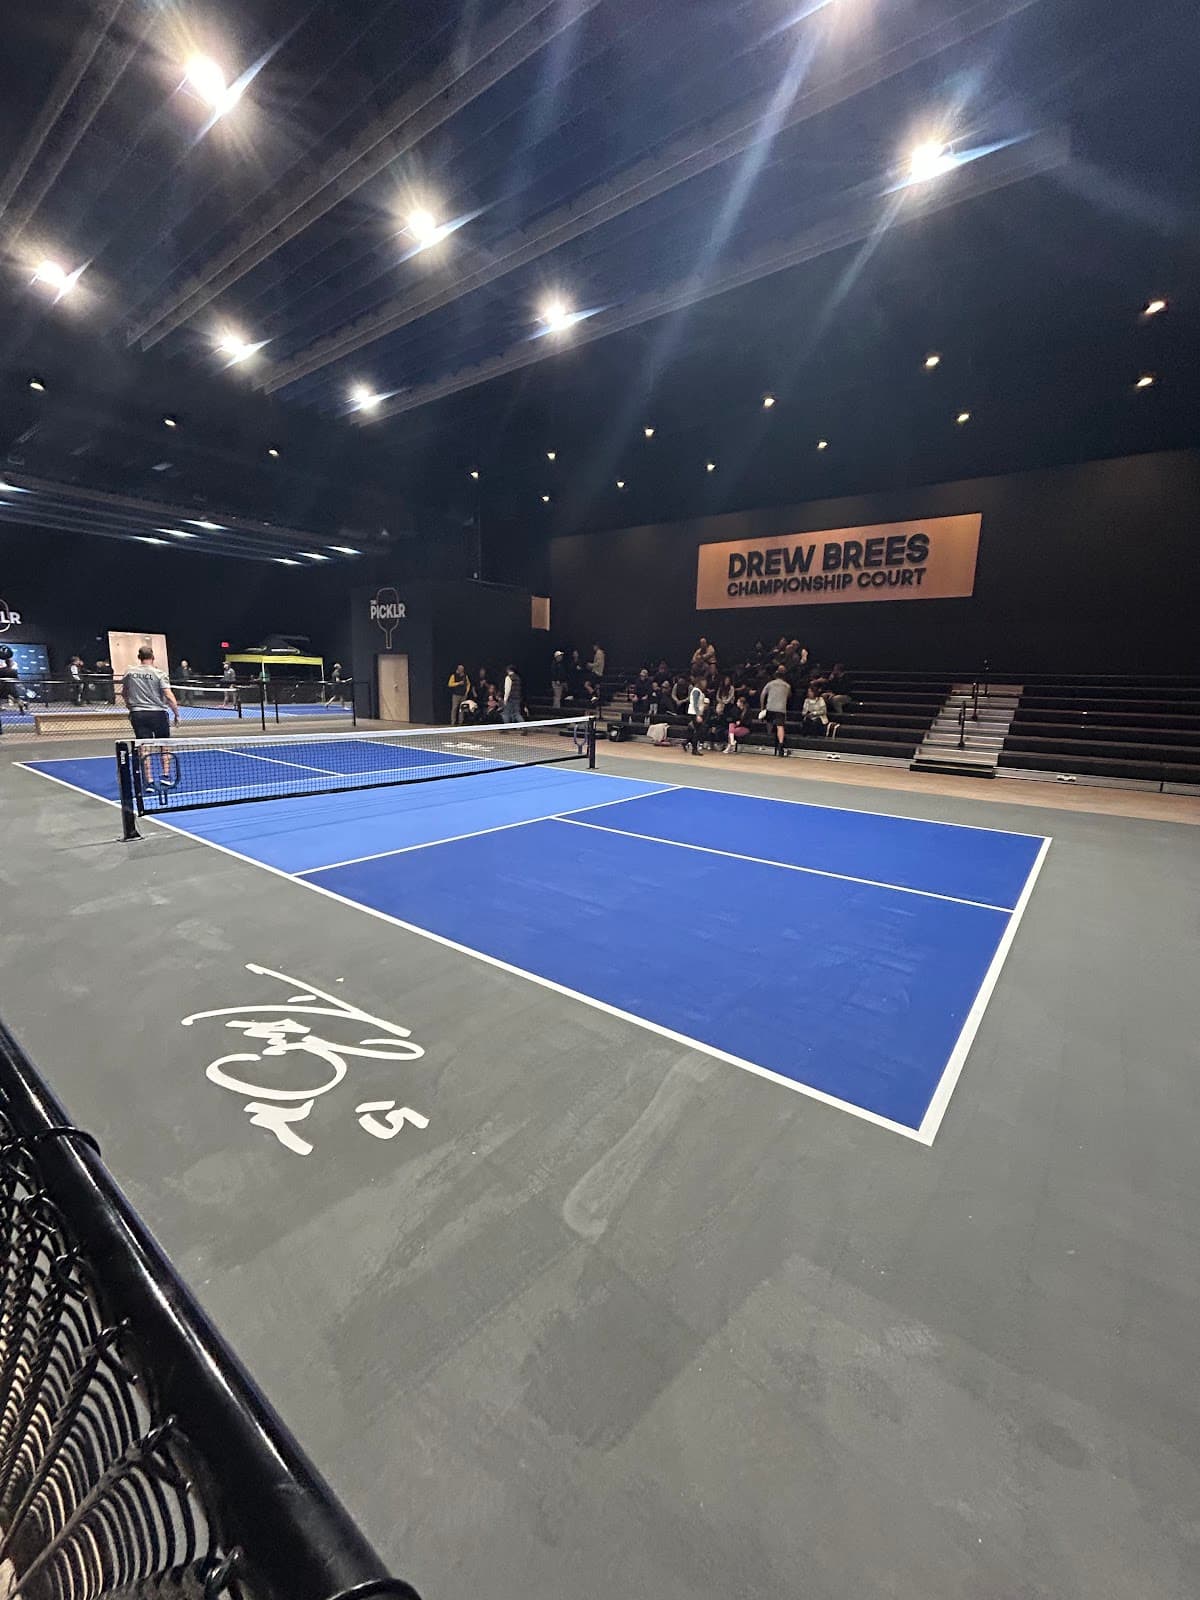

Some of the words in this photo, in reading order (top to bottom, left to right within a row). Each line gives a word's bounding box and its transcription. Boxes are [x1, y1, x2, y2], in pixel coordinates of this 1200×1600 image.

[728, 545, 817, 579] DREW
[823, 533, 930, 571] BREES
[727, 573, 853, 597] CHAMPIONSHIP
[857, 567, 927, 588] COURT
[370, 603, 406, 620] PICKLR
